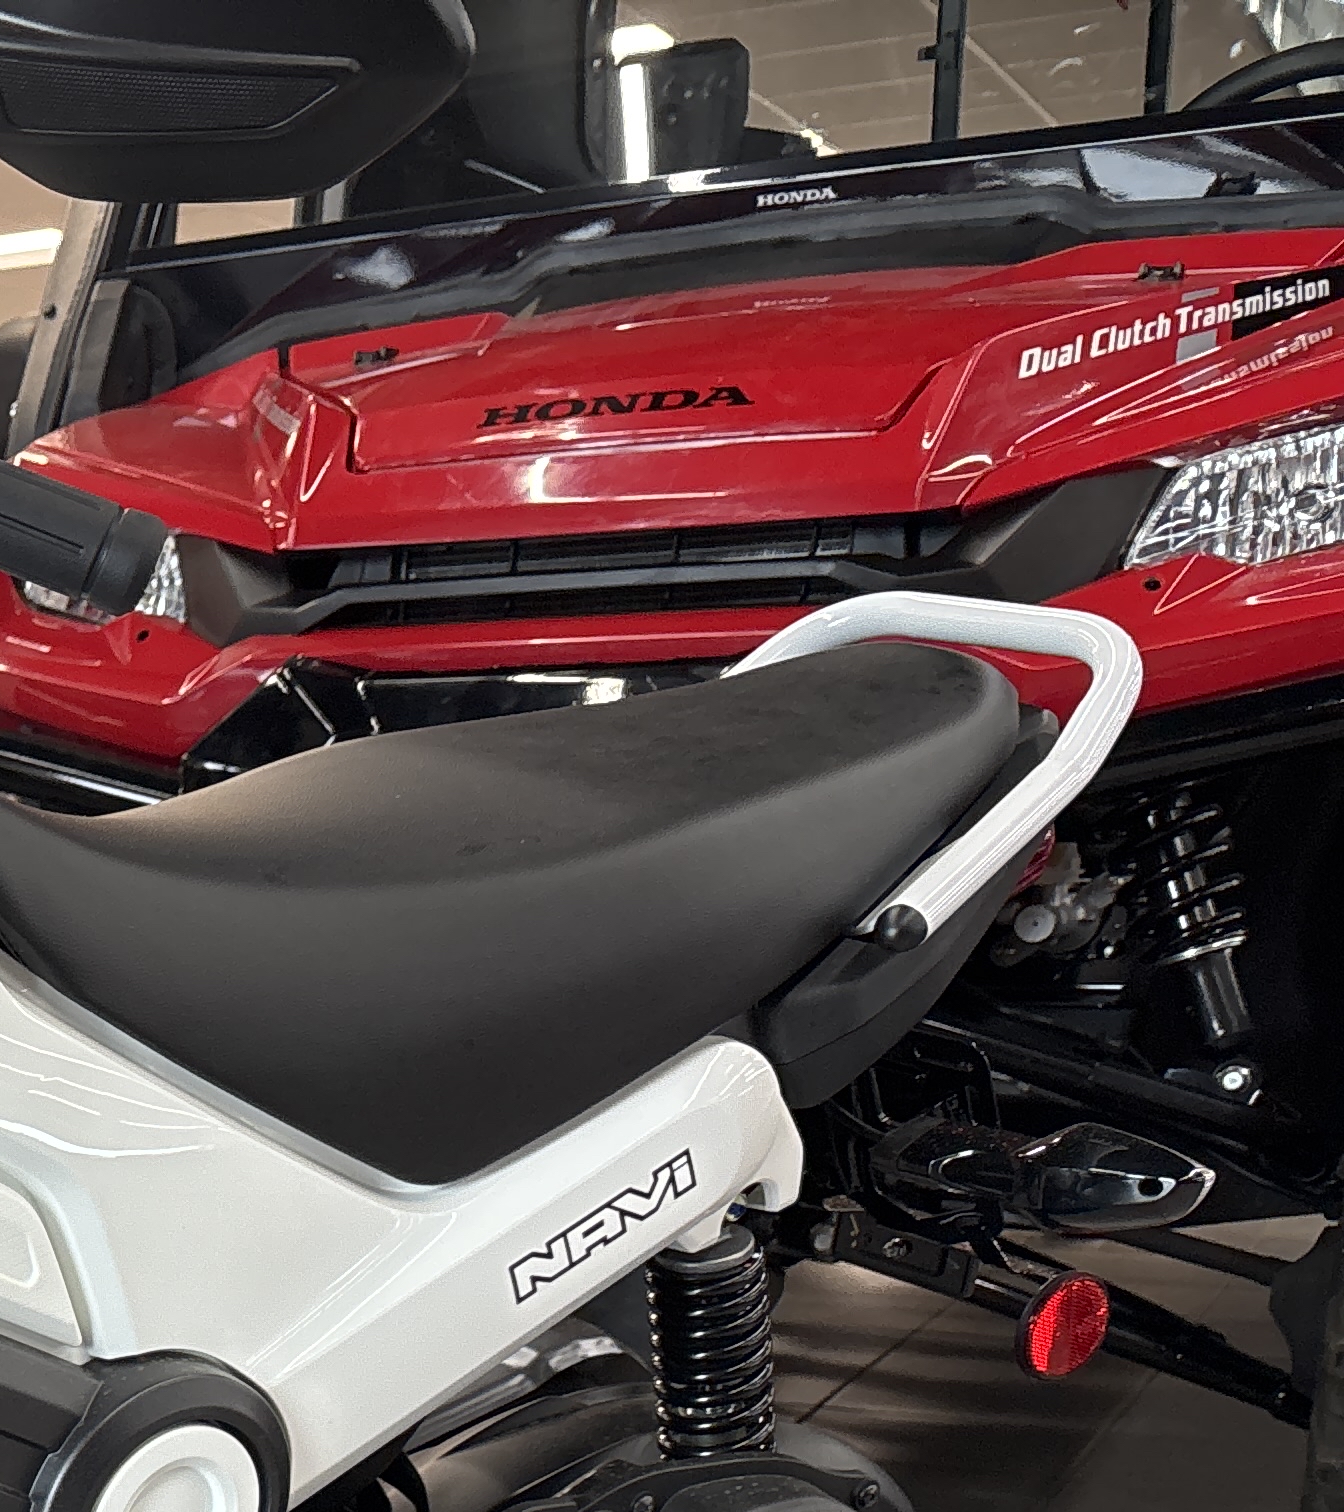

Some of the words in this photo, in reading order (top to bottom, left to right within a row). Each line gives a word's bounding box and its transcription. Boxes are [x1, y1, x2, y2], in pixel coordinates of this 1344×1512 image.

[756, 185, 837, 207] HONDA
[1018, 335, 1083, 379] Dual
[1090, 312, 1171, 358] Clutch
[1175, 278, 1331, 334] Transmission
[477, 386, 755, 429] HONDA
